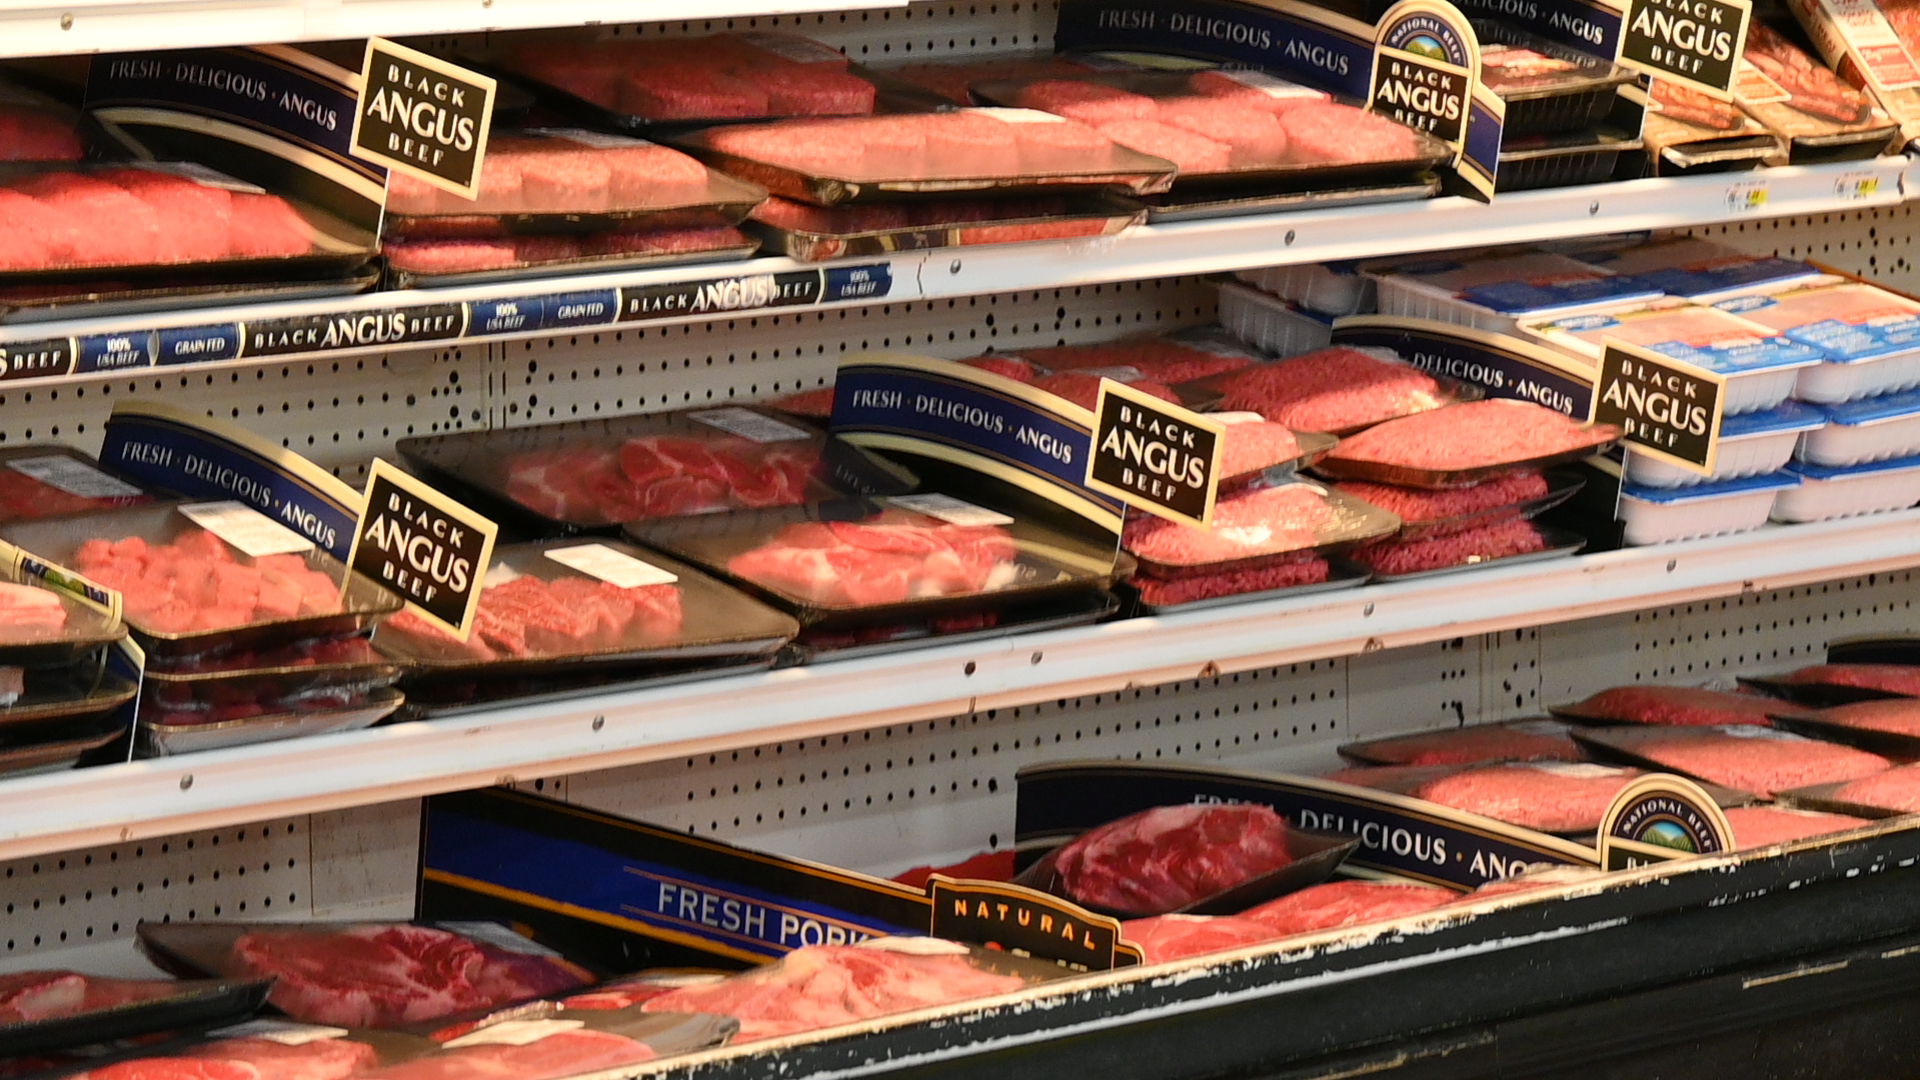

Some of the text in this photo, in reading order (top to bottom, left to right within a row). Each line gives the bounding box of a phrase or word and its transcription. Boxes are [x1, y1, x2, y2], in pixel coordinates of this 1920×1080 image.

[1391, 18, 1440, 44] NATIONAL
[1550, 10, 1604, 45] ANGUS
[1631, 6, 1732, 61] ANGUS
[1651, 0, 1724, 24] LACK
[1099, 10, 1349, 75] FRESH DELICIOUS ANGUS
[1651, 44, 1704, 74] BEEF
[109, 60, 337, 131] FRESH DELICIOUS ANGUS
[388, 64, 465, 107] BLACK
[1391, 62, 1452, 91] BLACK
[367, 86, 474, 152] ANGUS
[1377, 77, 1459, 120] ANGUS
[1395, 108, 1438, 132] BEEF
[388, 132, 445, 166] BEEF
[630, 293, 688, 313] BLACK
[690, 278, 768, 312] ANGUS
[107, 337, 131, 353] 100%
[175, 337, 225, 355] GRAIN FED
[255, 313, 455, 349] BLACK ANGUS BEEF
[14, 351, 61, 370] BEEF
[116, 350, 140, 366] BEEF
[1621, 360, 1698, 399] BLACK
[1413, 352, 1574, 415] DELICIOUS ANGUS
[853, 389, 1073, 465] FRESH DELICIOUS ANGUS
[1120, 405, 1196, 449] BLACK
[1602, 378, 1707, 436] ANGUS
[1624, 417, 1679, 448] BEEF
[1100, 425, 1205, 489] ANGUS
[121, 441, 337, 550] FRESH DELICIOUS ANGUS
[1122, 468, 1177, 501] BEEF
[388, 491, 465, 550] BLACK
[365, 513, 470, 594] ANGUS
[382, 560, 437, 603] BEEF
[1623, 799, 1714, 853] NATIONAL BEEF
[1469, 849, 1528, 880] ANG
[658, 882, 765, 939] FRESH
[954, 899, 1096, 950] NATURAL
